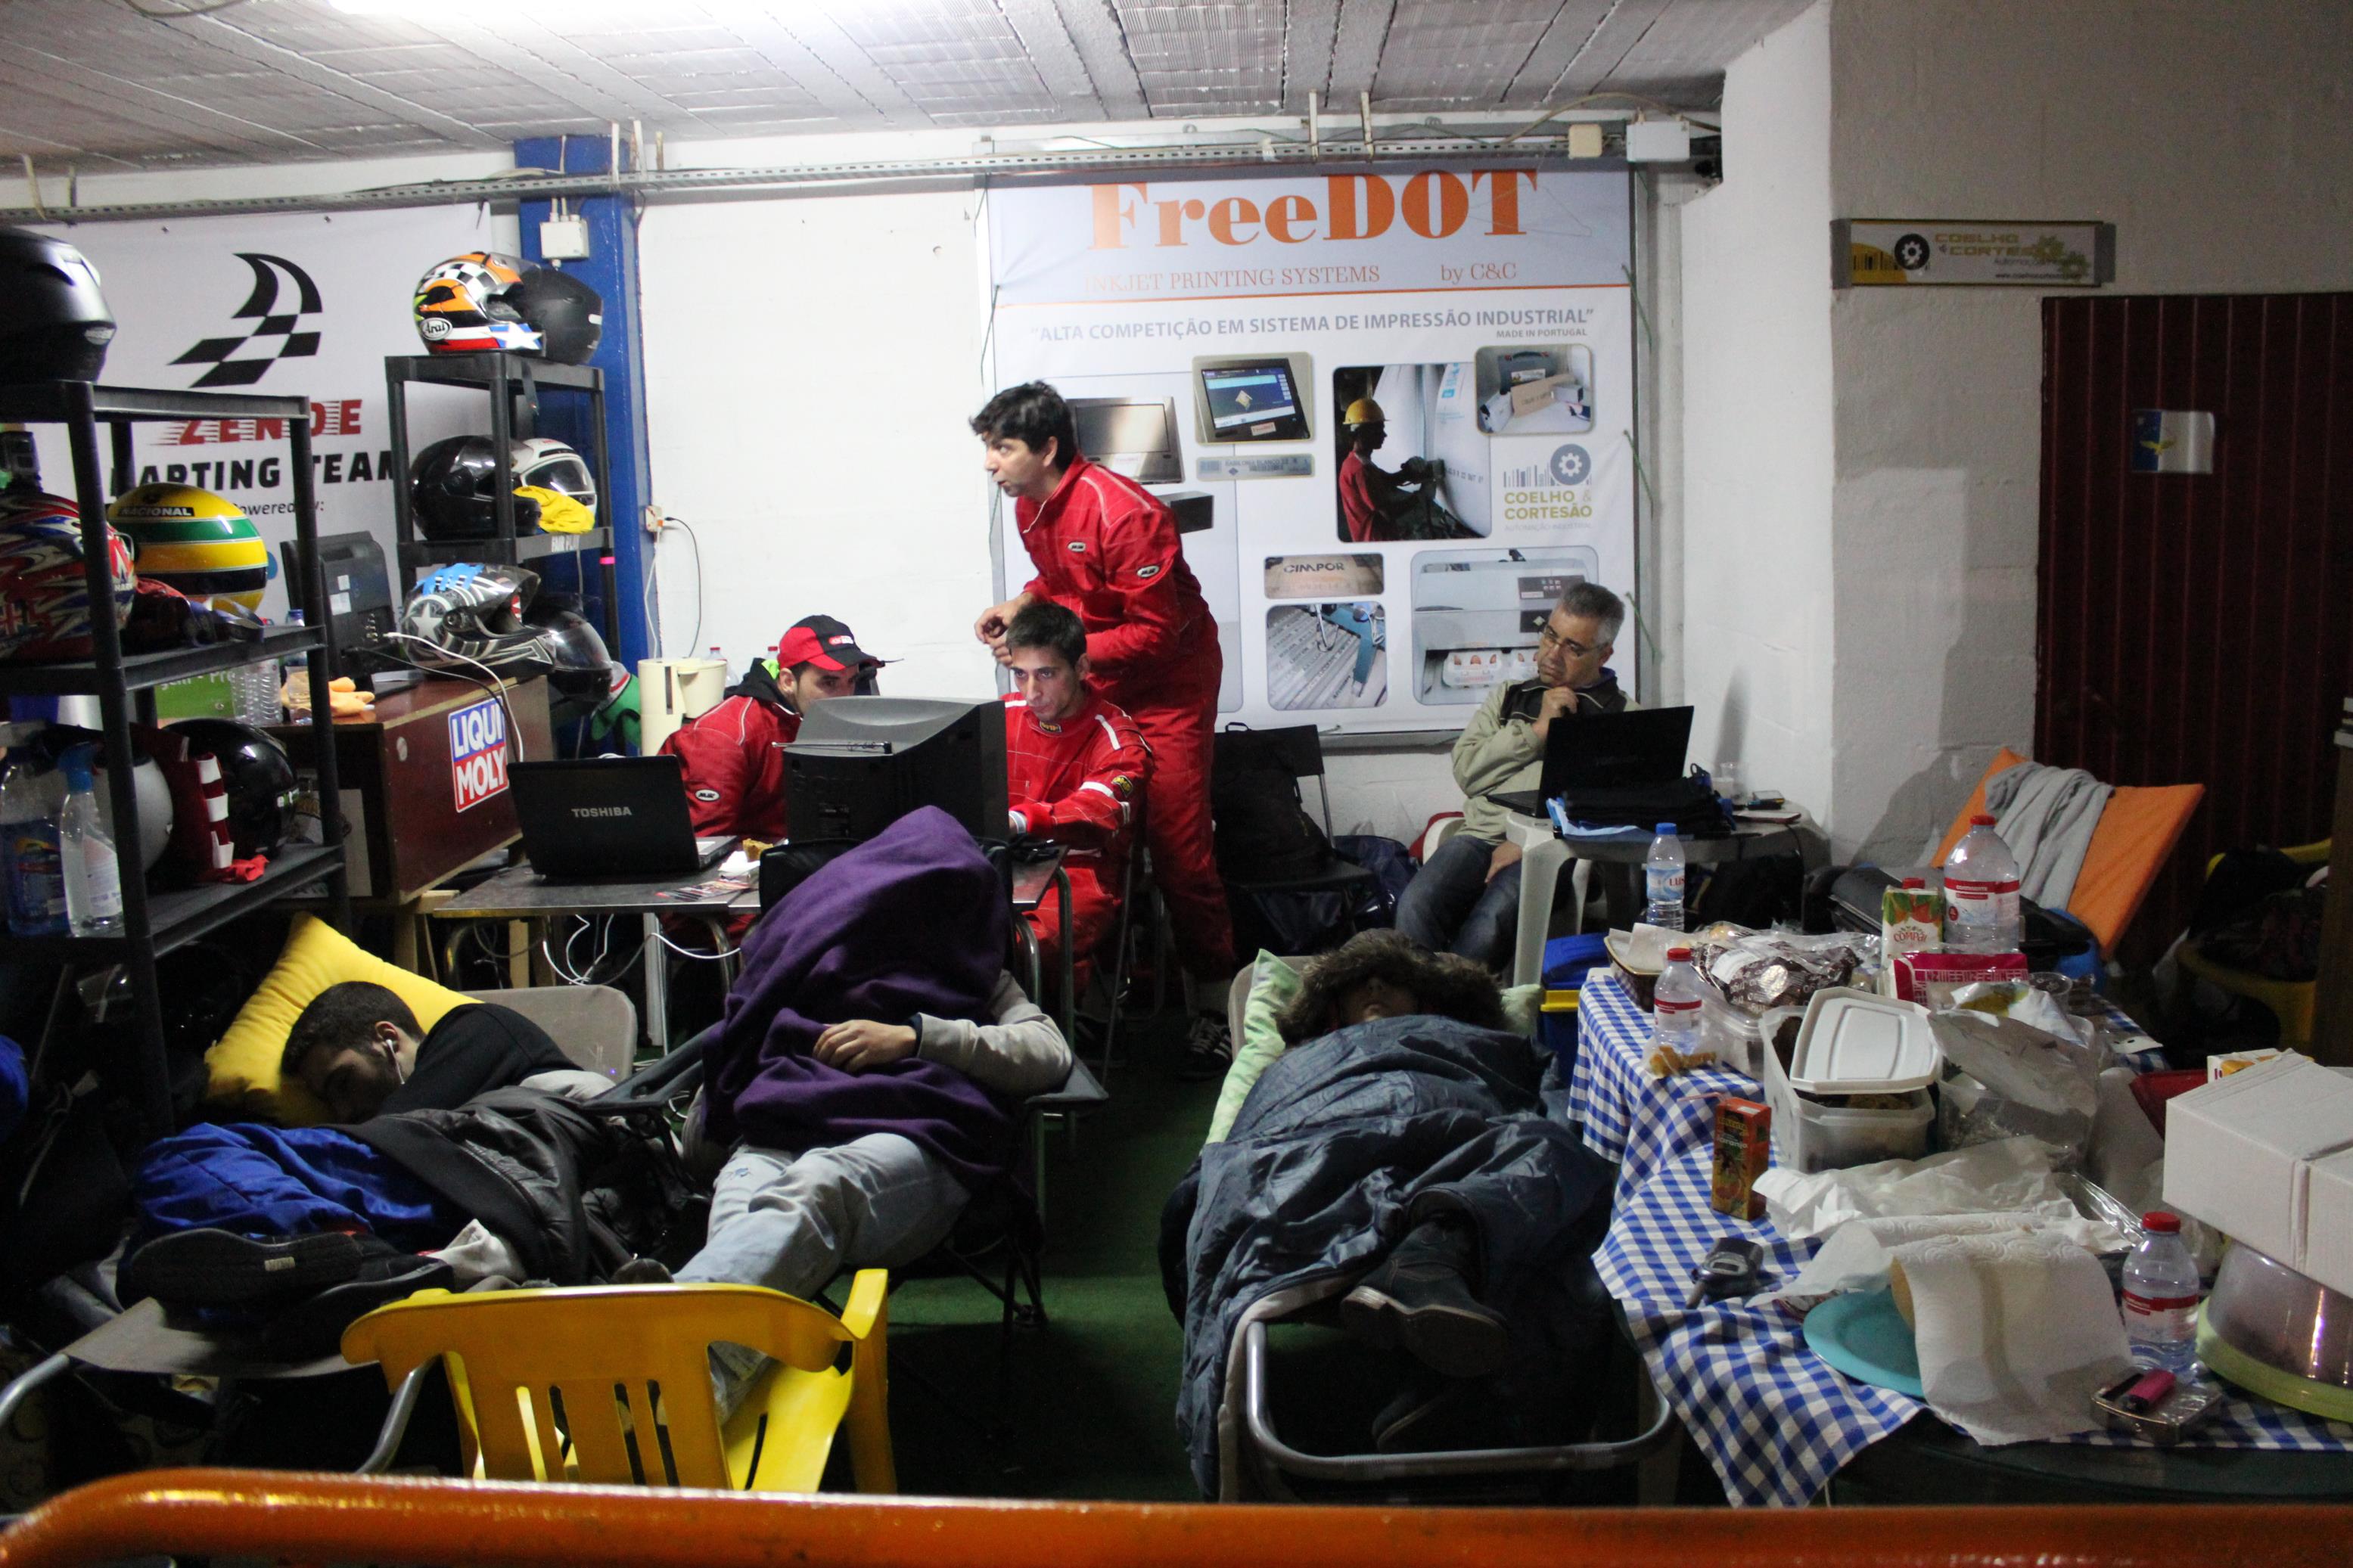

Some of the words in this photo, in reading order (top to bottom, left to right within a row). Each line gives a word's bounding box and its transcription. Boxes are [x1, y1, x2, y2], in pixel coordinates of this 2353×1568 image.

[1086, 169, 1538, 250] FreeDOT
[1085, 273, 1164, 293] INKJET
[1170, 268, 1275, 290] PRINTING
[1282, 265, 1381, 286] SYSTEMS
[1441, 264, 1463, 285] by
[1470, 262, 1517, 281] C&C
[1089, 318, 1212, 340] COMPETIÇÃO
[1217, 320, 1245, 334] EM
[1249, 315, 1330, 334] SISTEMA
[1335, 314, 1359, 330] DE
[1364, 309, 1471, 328] IMPRESSÃO
[1496, 330, 1524, 339] MADE
[1525, 329, 1535, 338] IN
[1537, 328, 1588, 337] PORTUGAL
[110, 457, 281, 496] ARTING
[1504, 490, 1575, 505] COELHO
[121, 507, 192, 517] NACIONAL
[1504, 503, 1593, 520] CORTESÃO
[1283, 561, 1345, 573] CIMPOR
[452, 703, 503, 759] LIQUI
[455, 746, 505, 806] MOLY
[570, 806, 633, 818] TOSHIBA
